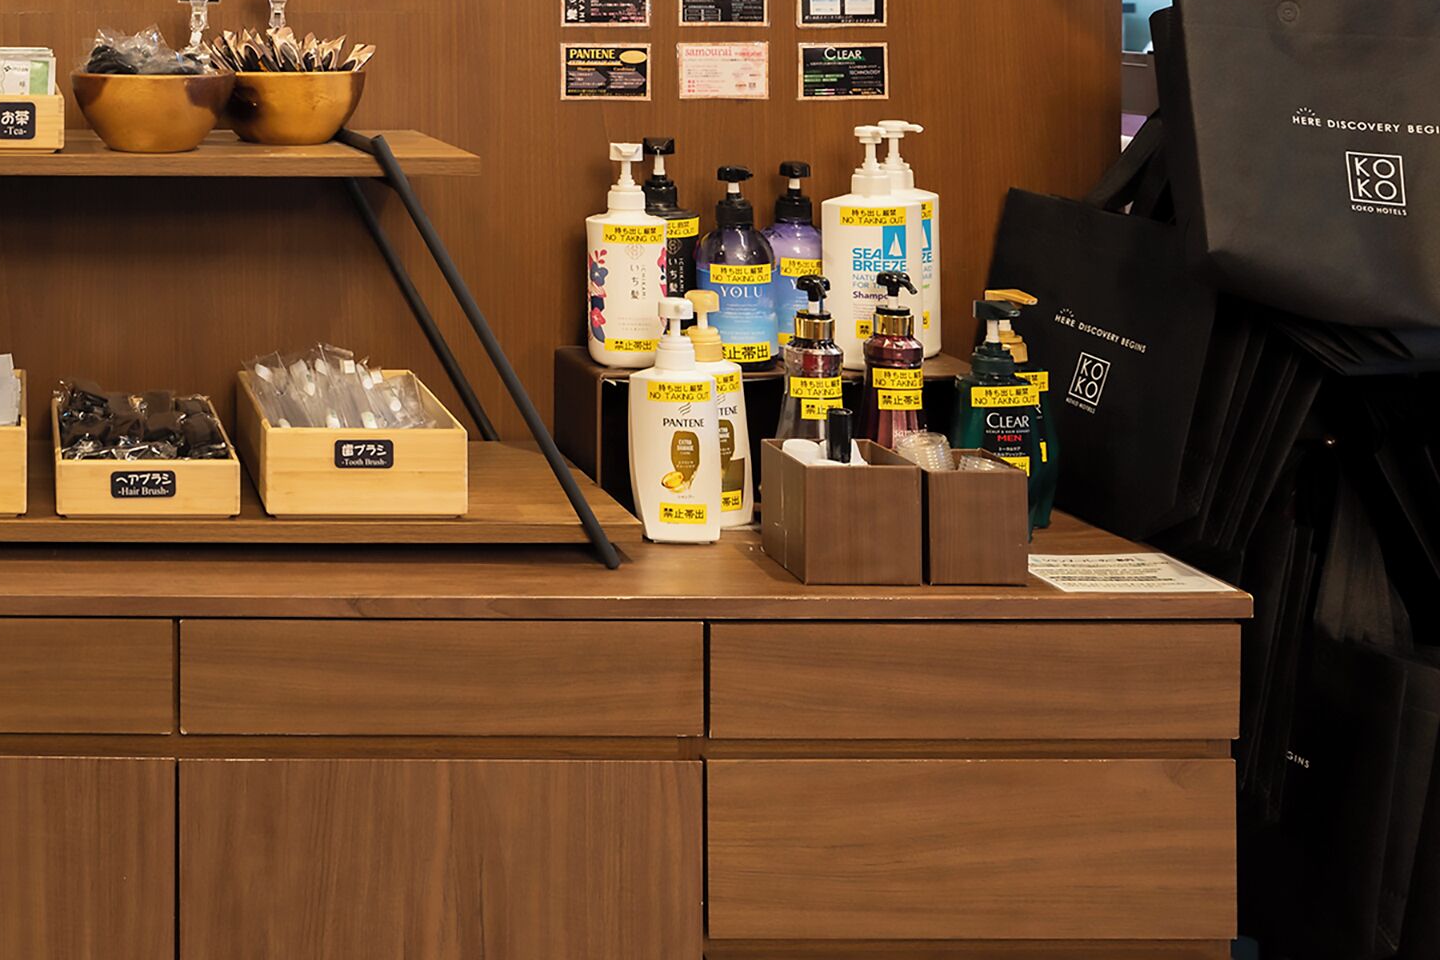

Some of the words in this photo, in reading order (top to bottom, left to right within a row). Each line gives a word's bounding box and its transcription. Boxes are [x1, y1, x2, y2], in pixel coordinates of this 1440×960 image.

[569, 49, 615, 59] PANTENE
[824, 46, 862, 60] CLEAR
[0, 110, 30, 126] お茶
[1292, 115, 1322, 127] HERE
[1327, 119, 1400, 133] DISCOVERY
[1407, 124, 1440, 134] BEGI
[1351, 204, 1374, 213] KOKO
[1376, 206, 1407, 216] HOTELS
[852, 247, 881, 259] SEA
[852, 260, 906, 272] BREEZE
[853, 273, 877, 281] NATU
[720, 286, 764, 297] YOLU
[853, 290, 888, 301] Shampo
[1055, 314, 1076, 328] HERE
[1078, 322, 1120, 343] DISCOVERY
[1120, 337, 1147, 354] BEGINS
[665, 392, 693, 400] TAKING
[696, 392, 708, 400] OUT
[991, 397, 1020, 405] TAKING
[1022, 395, 1036, 403] OUT
[719, 405, 738, 416] TENE
[662, 417, 704, 428] PANTENE
[986, 412, 1030, 429] CLEAR
[341, 444, 387, 457] 歯ブラシ
[115, 473, 172, 485] ヘアブラシ
[118, 486, 140, 496] -Hair
[141, 486, 169, 496] Brush-
[1286, 750, 1310, 769] GINS
